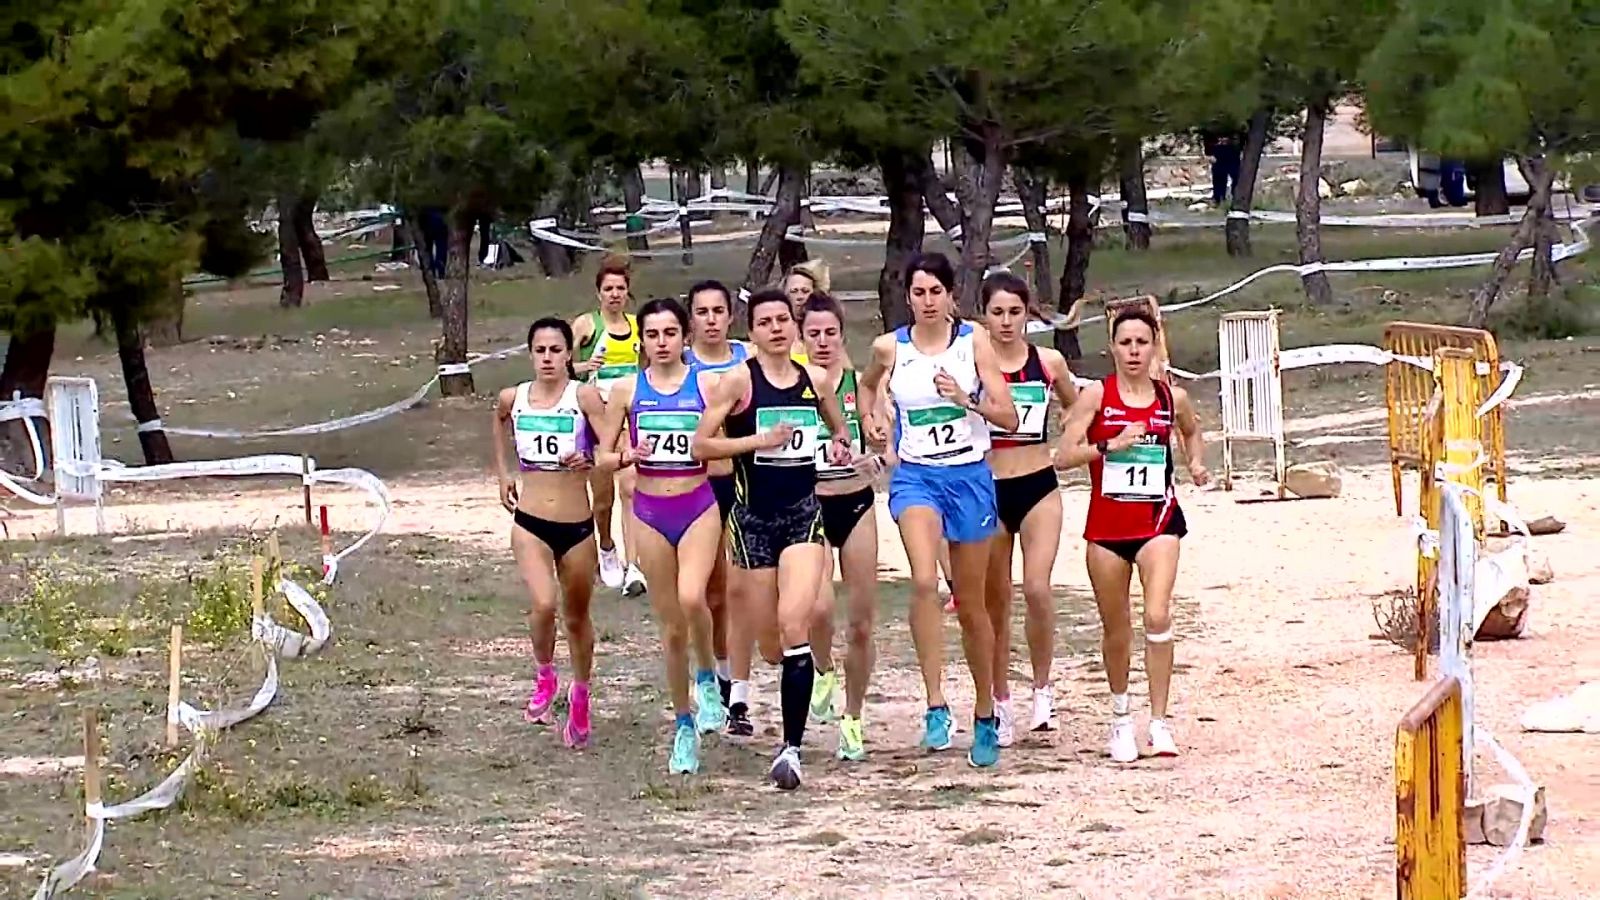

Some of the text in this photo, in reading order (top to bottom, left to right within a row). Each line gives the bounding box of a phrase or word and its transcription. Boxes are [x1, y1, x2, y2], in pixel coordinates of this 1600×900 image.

[532, 434, 559, 456] 16
[645, 432, 690, 456] 749
[927, 424, 957, 447] 12
[1125, 465, 1149, 487] 11
